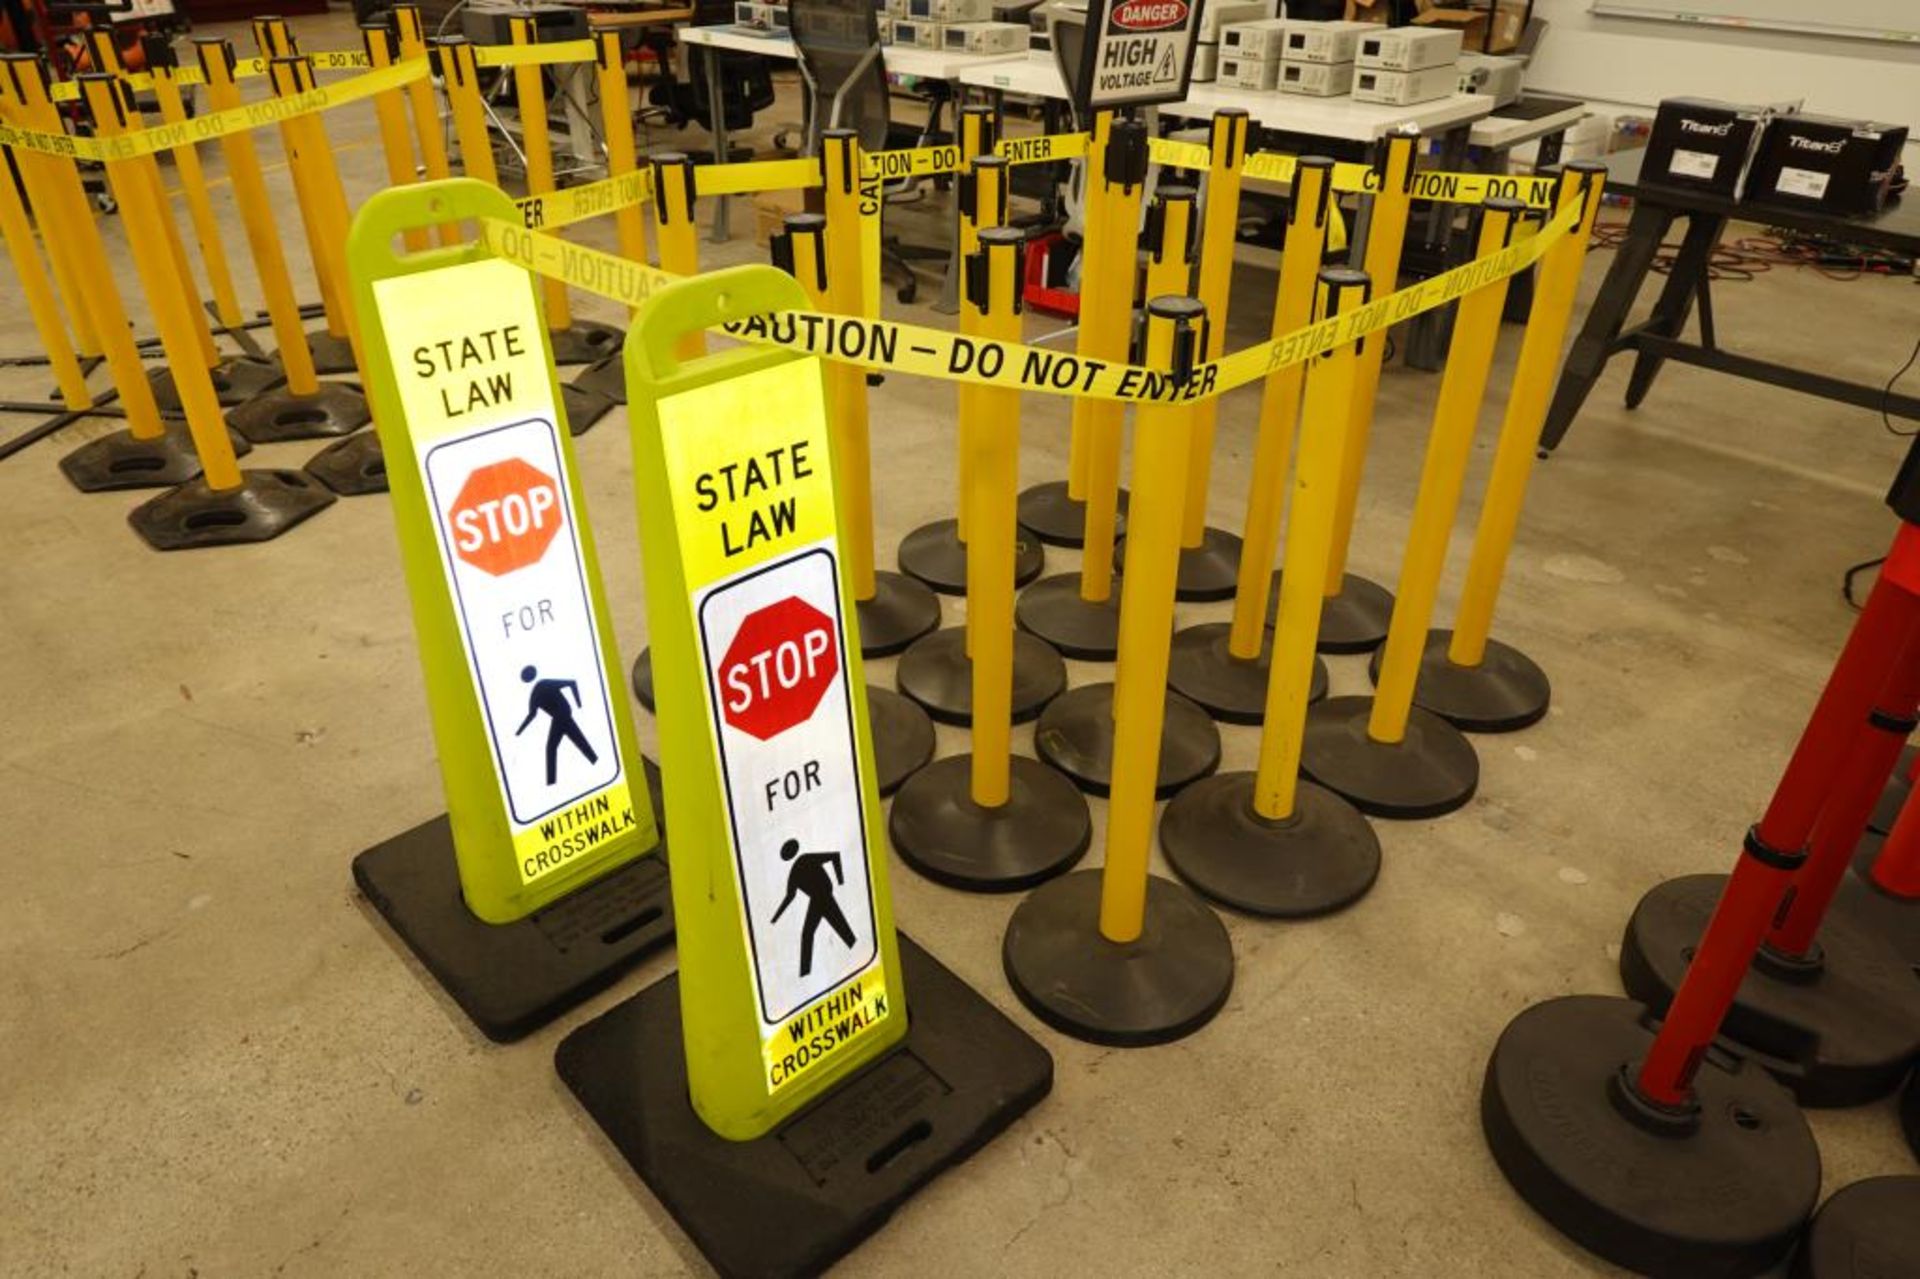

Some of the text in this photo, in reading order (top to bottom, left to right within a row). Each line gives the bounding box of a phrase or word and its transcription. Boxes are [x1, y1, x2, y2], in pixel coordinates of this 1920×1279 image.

[1121, 3, 1179, 23] DANGER
[1100, 71, 1153, 91] VOLTAGE
[1103, 38, 1158, 68] HIGH
[414, 325, 525, 378] STATE
[948, 337, 1005, 378] DO
[1021, 351, 1107, 392] NOT
[1115, 363, 1219, 402] ENTER
[441, 372, 513, 417] LAW
[696, 440, 813, 512] STATE
[456, 485, 553, 552] STOP
[721, 497, 796, 558] LAW
[502, 599, 555, 638] FOR
[727, 629, 829, 714] STOP
[765, 760, 822, 812] FOR
[523, 808, 636, 878] CROSSWALK
[540, 795, 609, 841] WITHIN
[770, 995, 887, 1086] CROSSWALK
[788, 982, 863, 1043] WITHIN
